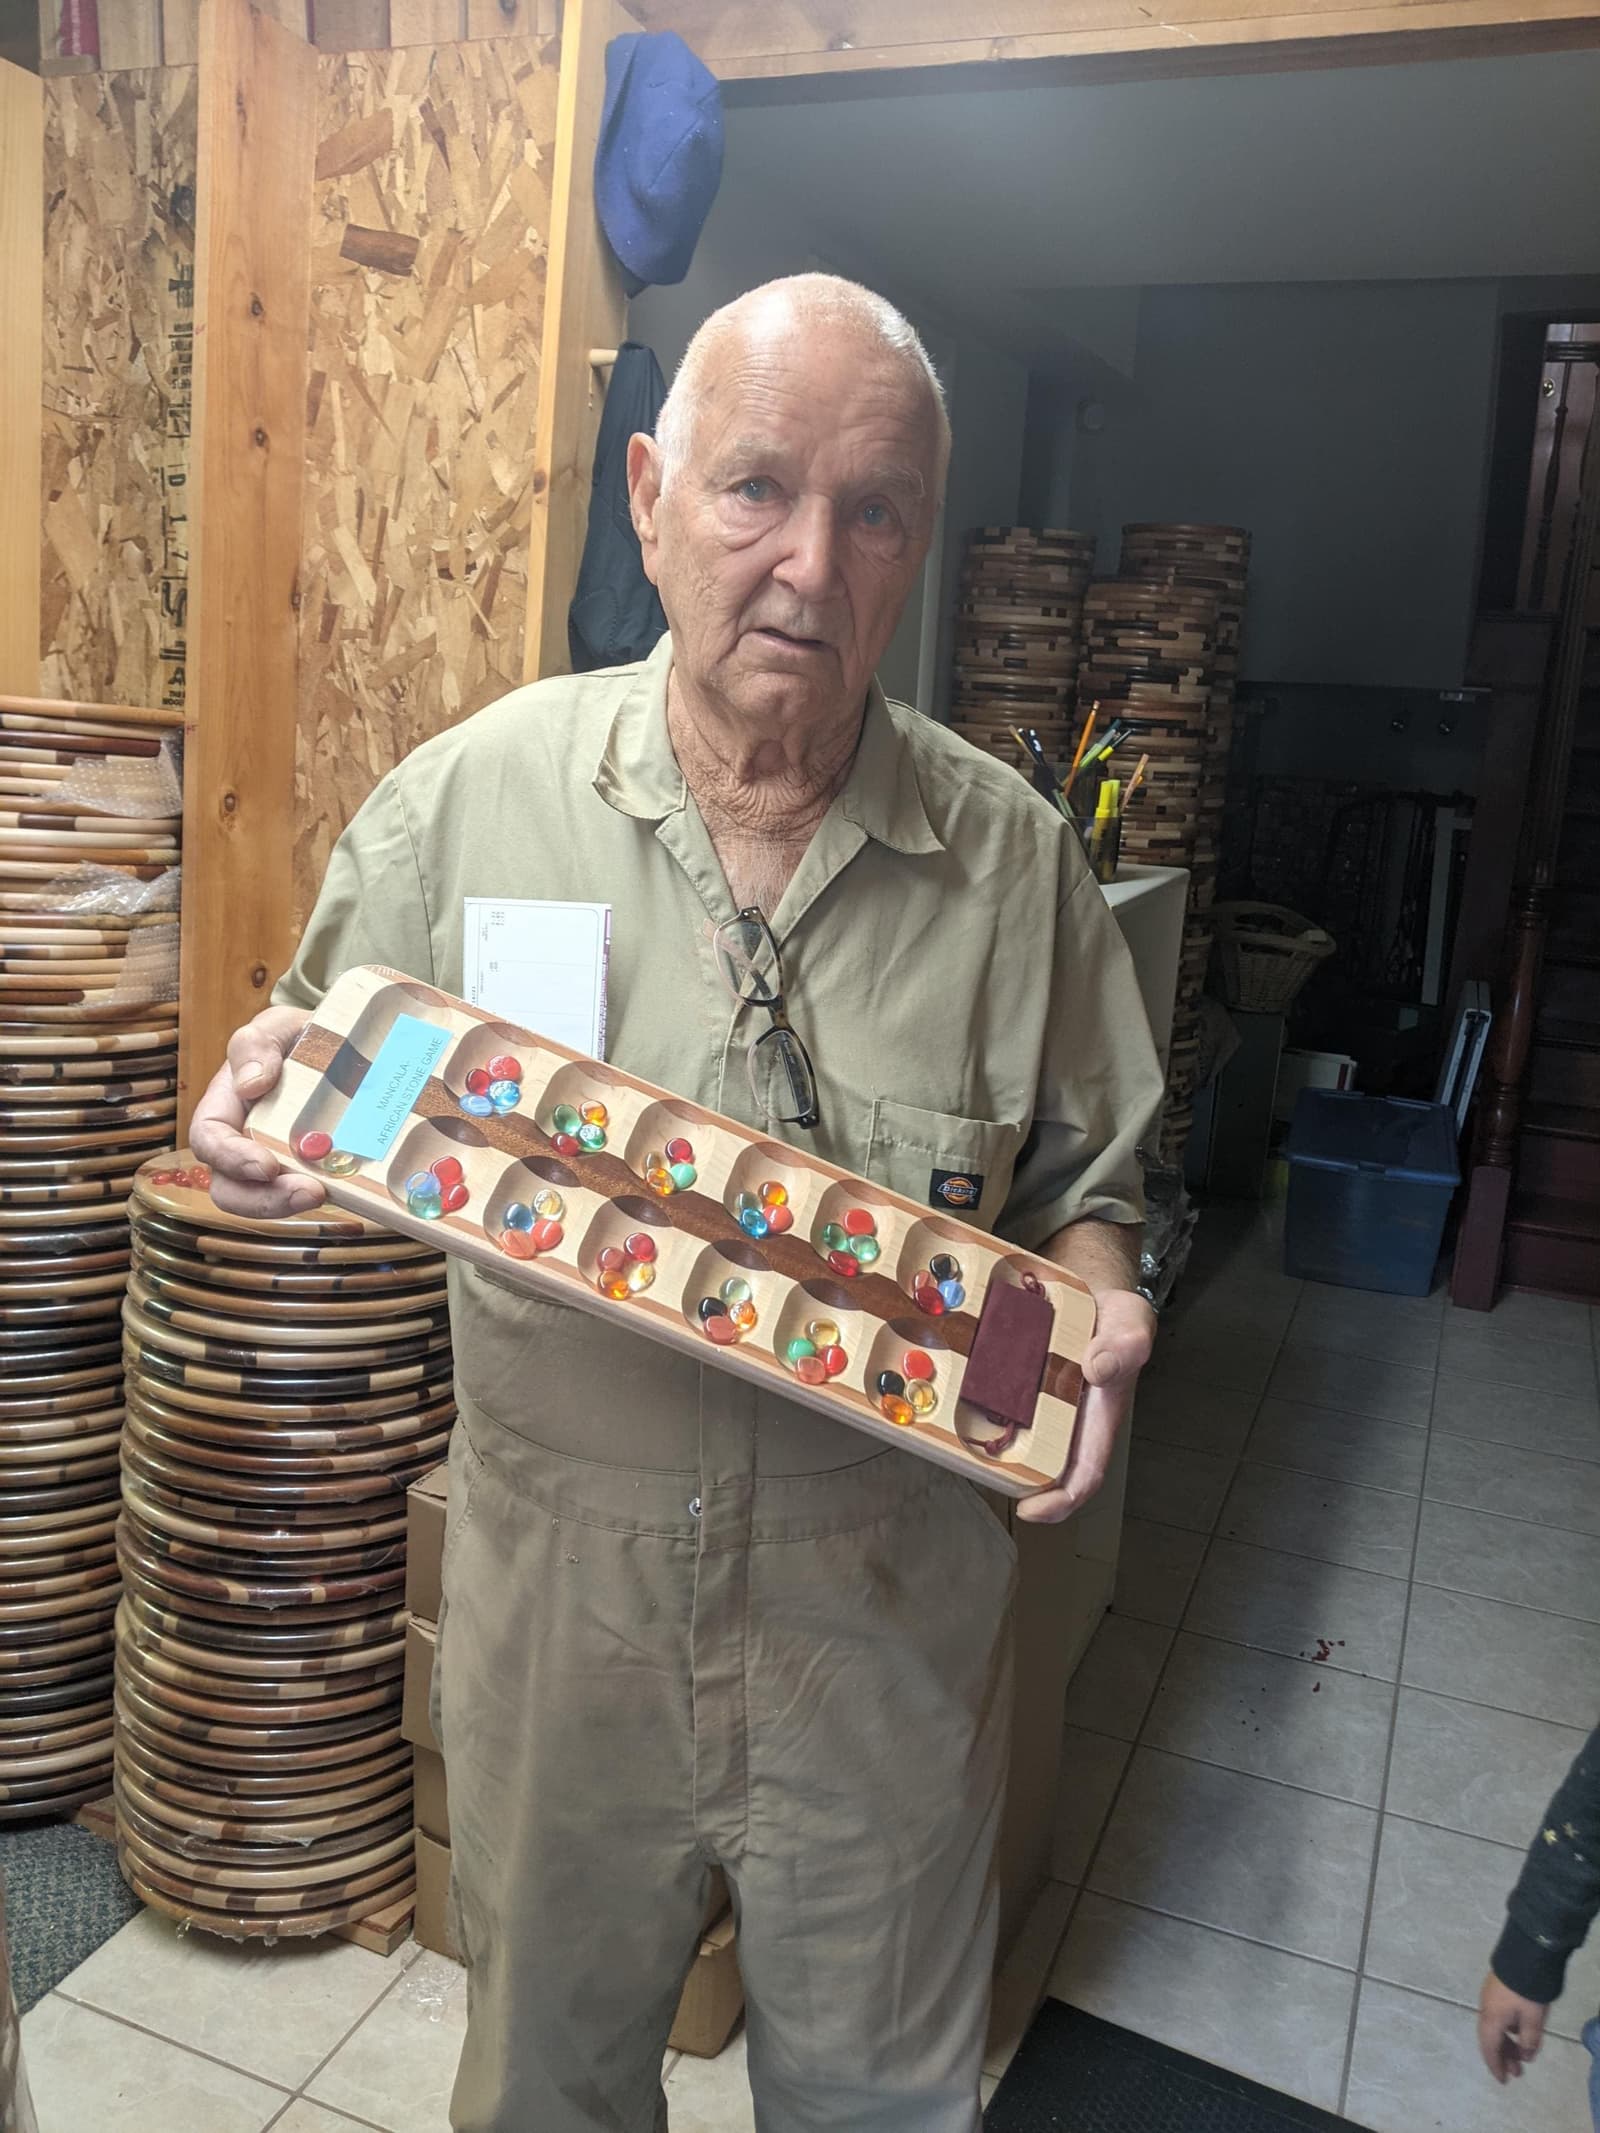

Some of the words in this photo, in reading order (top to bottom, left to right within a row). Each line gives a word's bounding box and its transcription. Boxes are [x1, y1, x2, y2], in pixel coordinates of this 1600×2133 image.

[377, 1101, 409, 1145] AFRICAN
[402, 1066, 426, 1101] STONE
[422, 1037, 442, 1066] GAME
